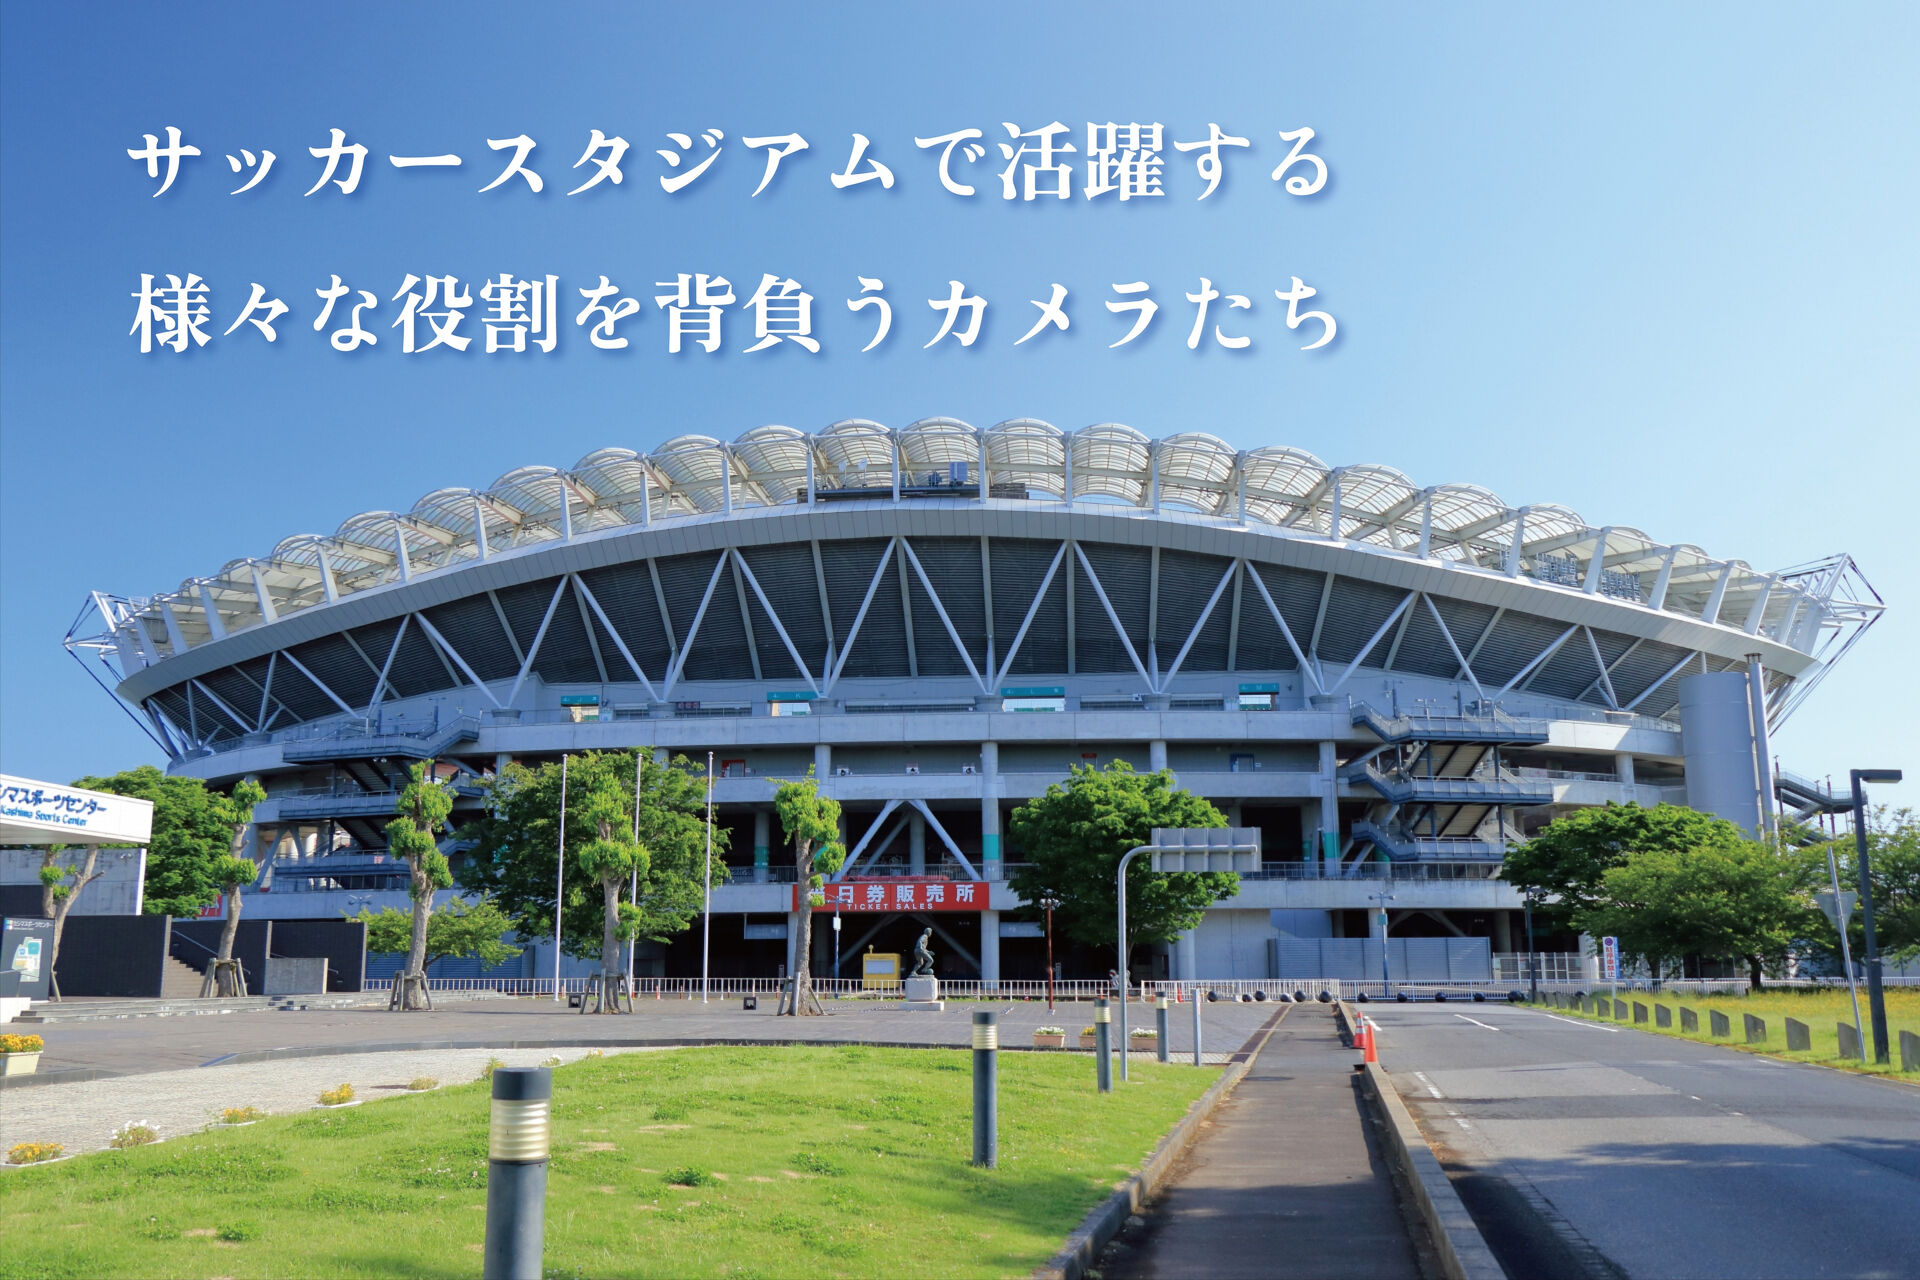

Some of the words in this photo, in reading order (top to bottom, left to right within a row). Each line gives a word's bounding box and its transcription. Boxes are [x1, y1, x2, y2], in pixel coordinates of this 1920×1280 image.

[35, 810, 60, 822] Sports
[62, 814, 88, 826] Center
[848, 903, 888, 911] TICKET
[896, 902, 933, 910] SALES
